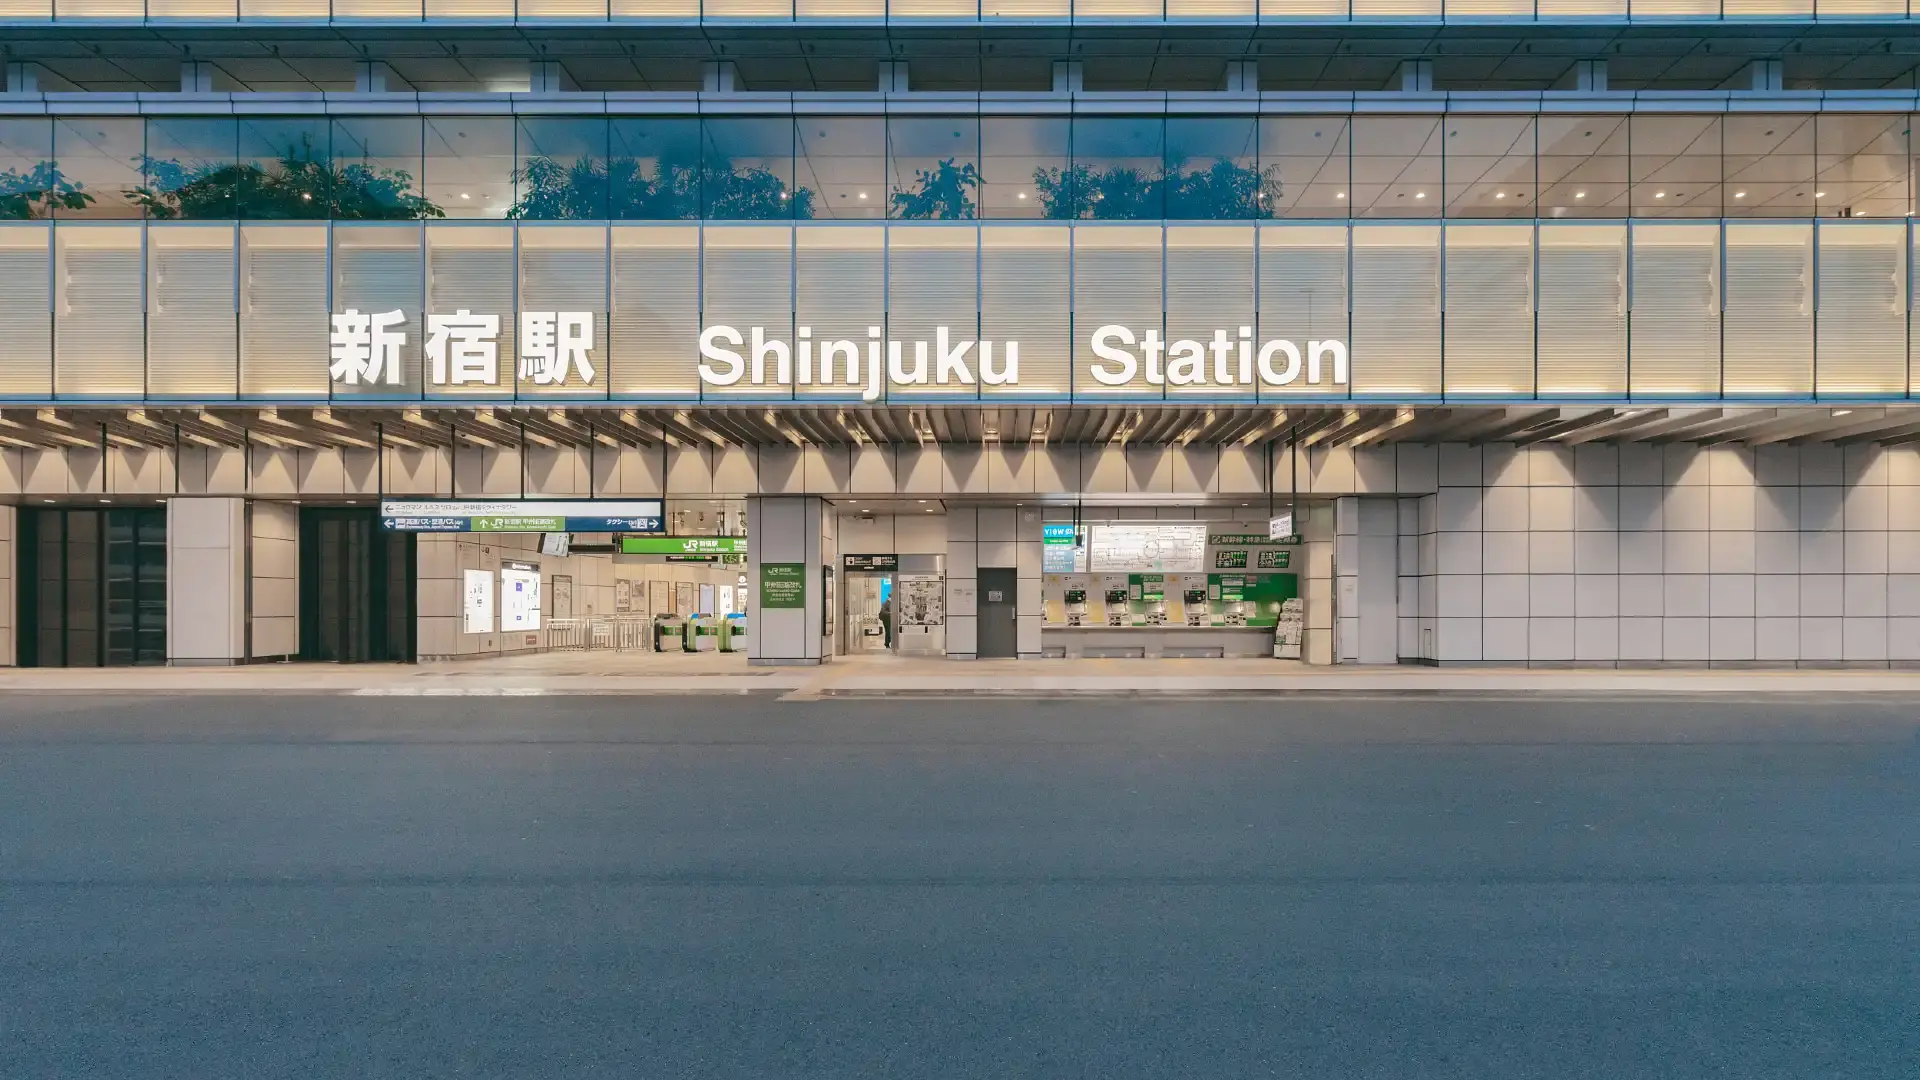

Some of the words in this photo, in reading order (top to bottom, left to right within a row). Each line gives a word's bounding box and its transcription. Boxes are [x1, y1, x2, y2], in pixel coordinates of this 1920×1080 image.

[330, 309, 597, 385] 新宿駅
[698, 325, 1019, 402] Shinjuku
[1089, 325, 1349, 386] Station
[491, 518, 504, 527] JR
[683, 540, 698, 549] JR
